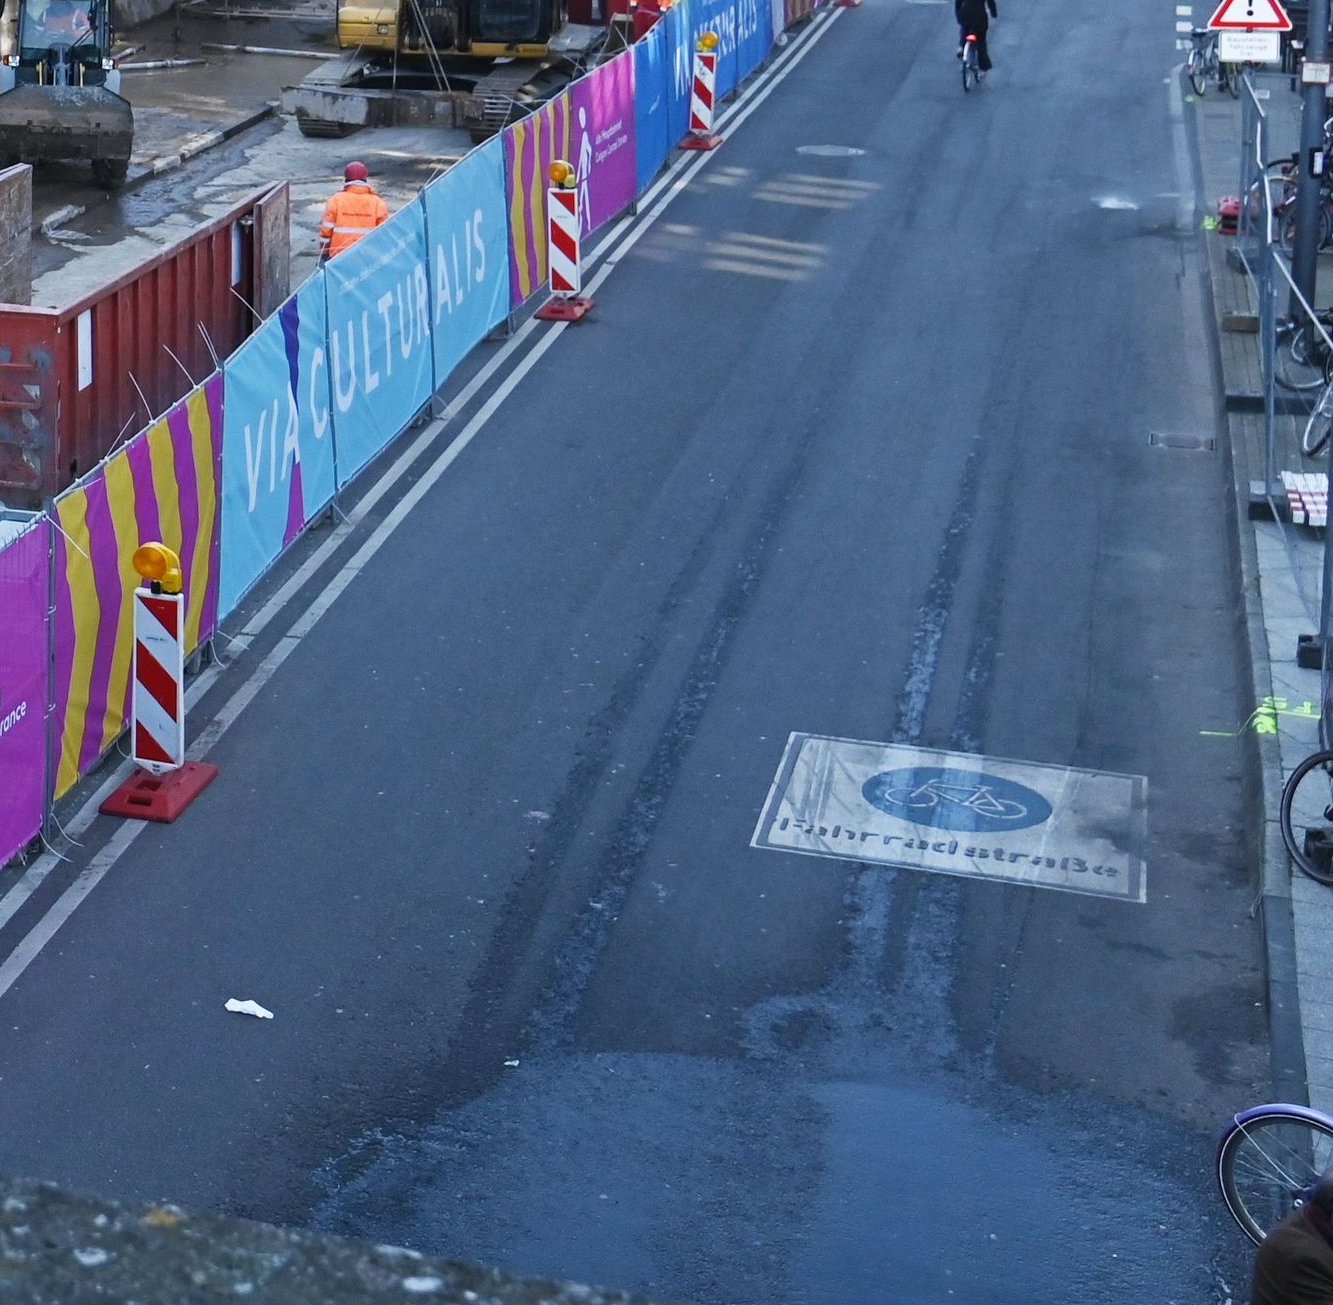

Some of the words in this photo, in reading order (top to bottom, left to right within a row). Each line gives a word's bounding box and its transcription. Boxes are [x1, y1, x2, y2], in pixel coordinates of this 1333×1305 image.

[244, 380, 301, 512] VIA
[309, 209, 486, 440] CULTURALIS
[773, 816, 1121, 878] Fahrradstraße
